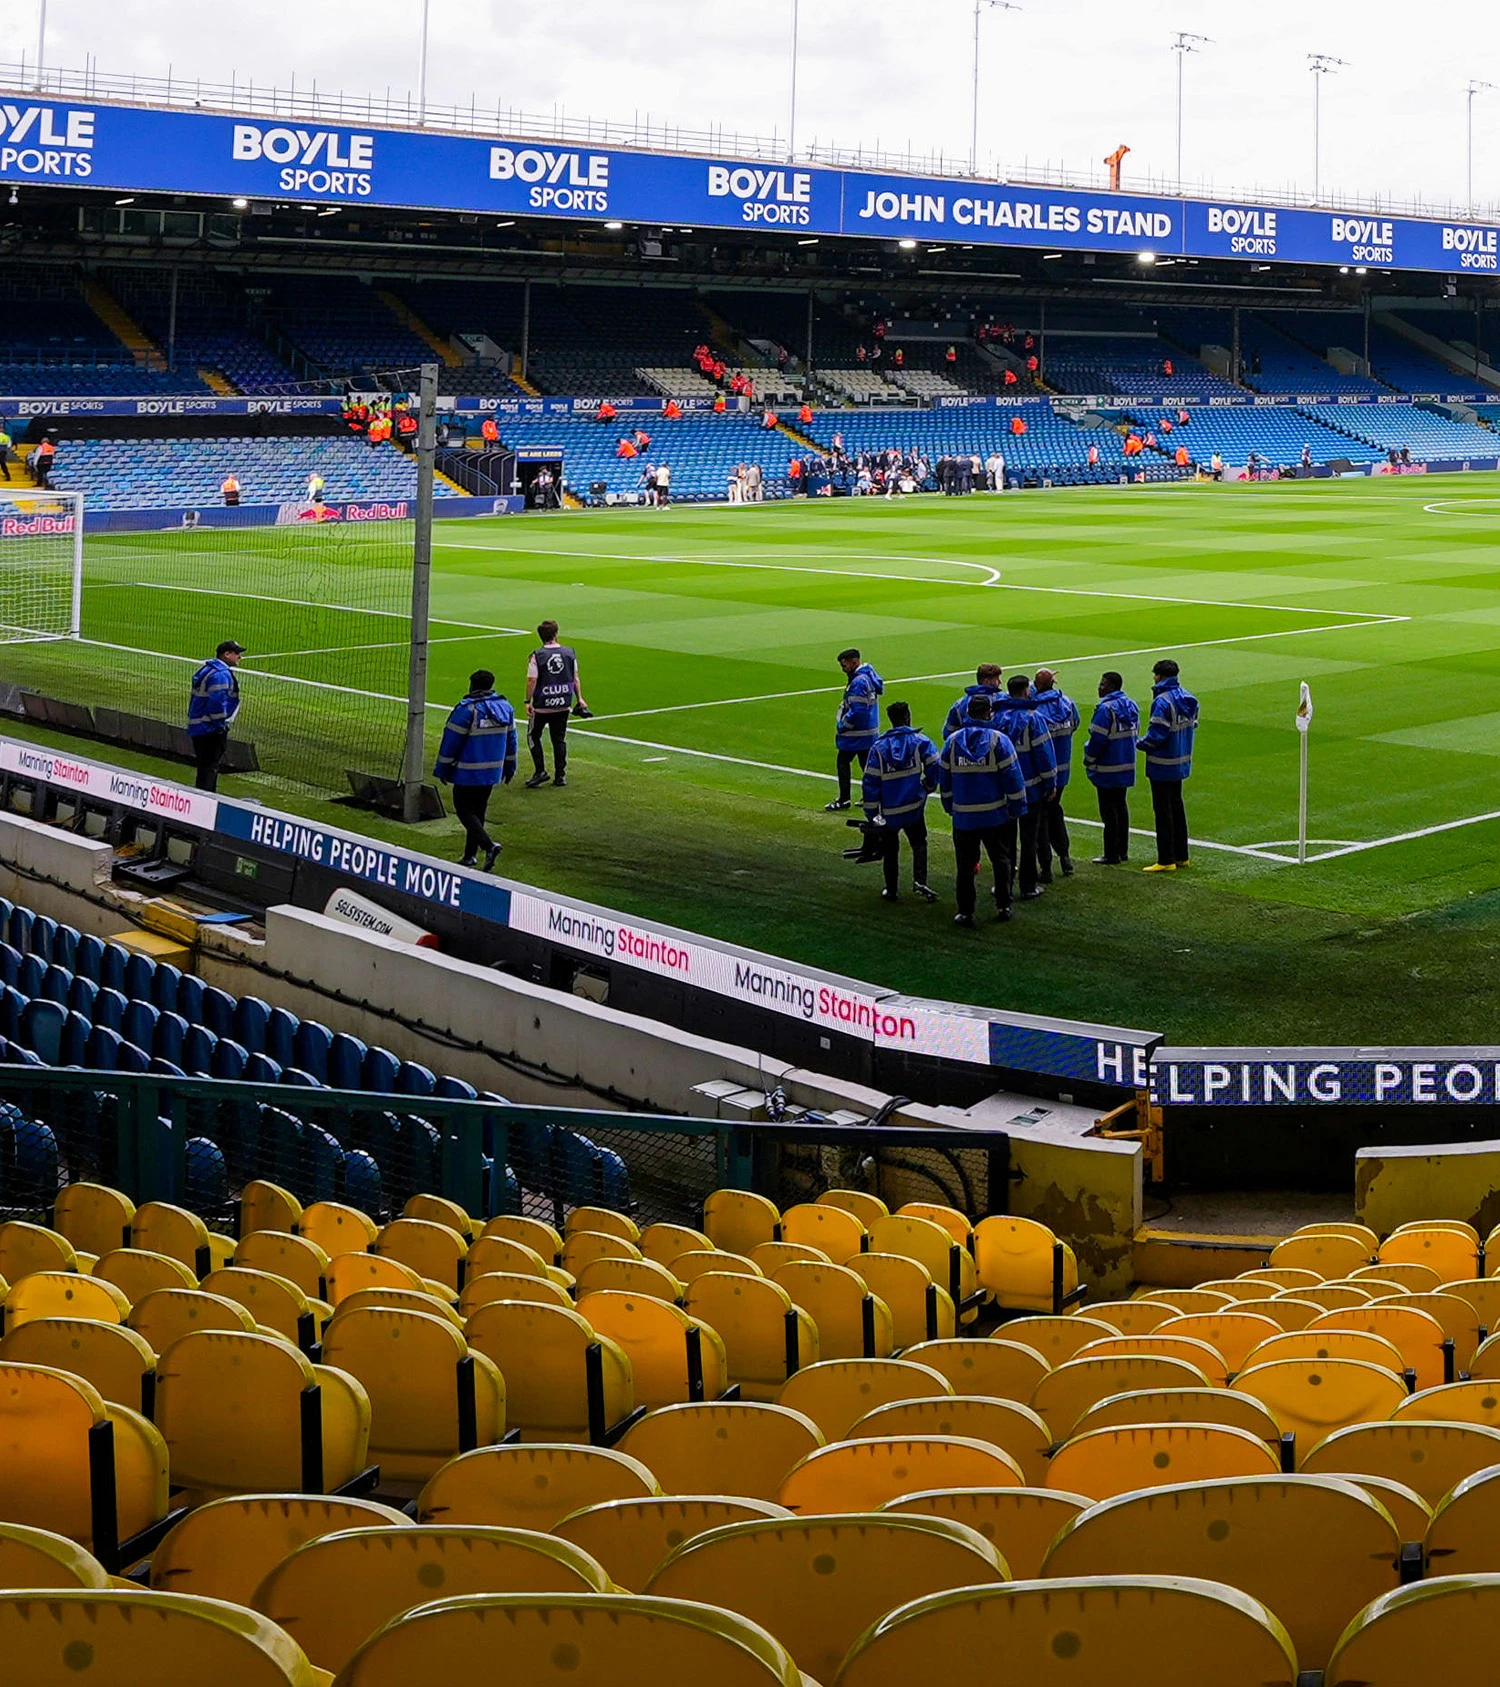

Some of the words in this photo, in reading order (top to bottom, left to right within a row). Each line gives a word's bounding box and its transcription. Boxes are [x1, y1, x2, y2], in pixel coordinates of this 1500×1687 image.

[0, 104, 95, 148] YLE
[233, 124, 374, 170] BOYLE
[489, 146, 608, 187] BOYLE
[279, 168, 372, 196] SPORTS
[708, 166, 811, 202] BOYLE
[529, 186, 607, 212] SPORTS
[742, 202, 809, 225] SPORTS
[859, 191, 945, 222] JOHN
[952, 199, 1081, 233] CHARLES
[1086, 207, 1171, 238] STAND
[1208, 207, 1276, 236] BOYLE
[1331, 218, 1393, 245] BOYLE
[1442, 228, 1497, 252] BOYLE
[1231, 236, 1276, 255] SPORTS
[1352, 245, 1393, 262] SPORTS
[1461, 252, 1497, 269] SPORTS
[18, 401, 70, 415] BOYLE
[71, 402, 104, 411] SPORTS
[137, 401, 185, 413] BOYLE
[186, 401, 217, 410] SPORTS
[293, 400, 322, 409] SPORTS
[941, 397, 968, 406] BOYLE
[996, 397, 1023, 406] BOYLE
[1113, 397, 1137, 406] BOYLE
[1163, 397, 1186, 405] BOYLE
[1209, 397, 1231, 405] BOYLE
[1254, 396, 1275, 405] BOYLE
[347, 503, 378, 520] Red
[378, 502, 408, 518] Bull
[2, 519, 41, 536] Red
[41, 517, 77, 534] Bull
[542, 684, 569, 695] CLUB
[19, 750, 53, 779] Manning
[54, 758, 89, 785] Stainton
[109, 773, 149, 806] Manning
[150, 786, 191, 815] Stainton
[251, 815, 324, 862] HELPING
[329, 838, 397, 887] PEOPLE
[405, 863, 461, 907] MOVE
[335, 899, 393, 935] SGLSYSTEM.COM
[548, 906, 615, 954] Manning
[618, 927, 689, 970] Stainton
[735, 962, 815, 1018] Manning
[819, 988, 916, 1040] Stainton
[1097, 1042, 1341, 1102] HELPING
